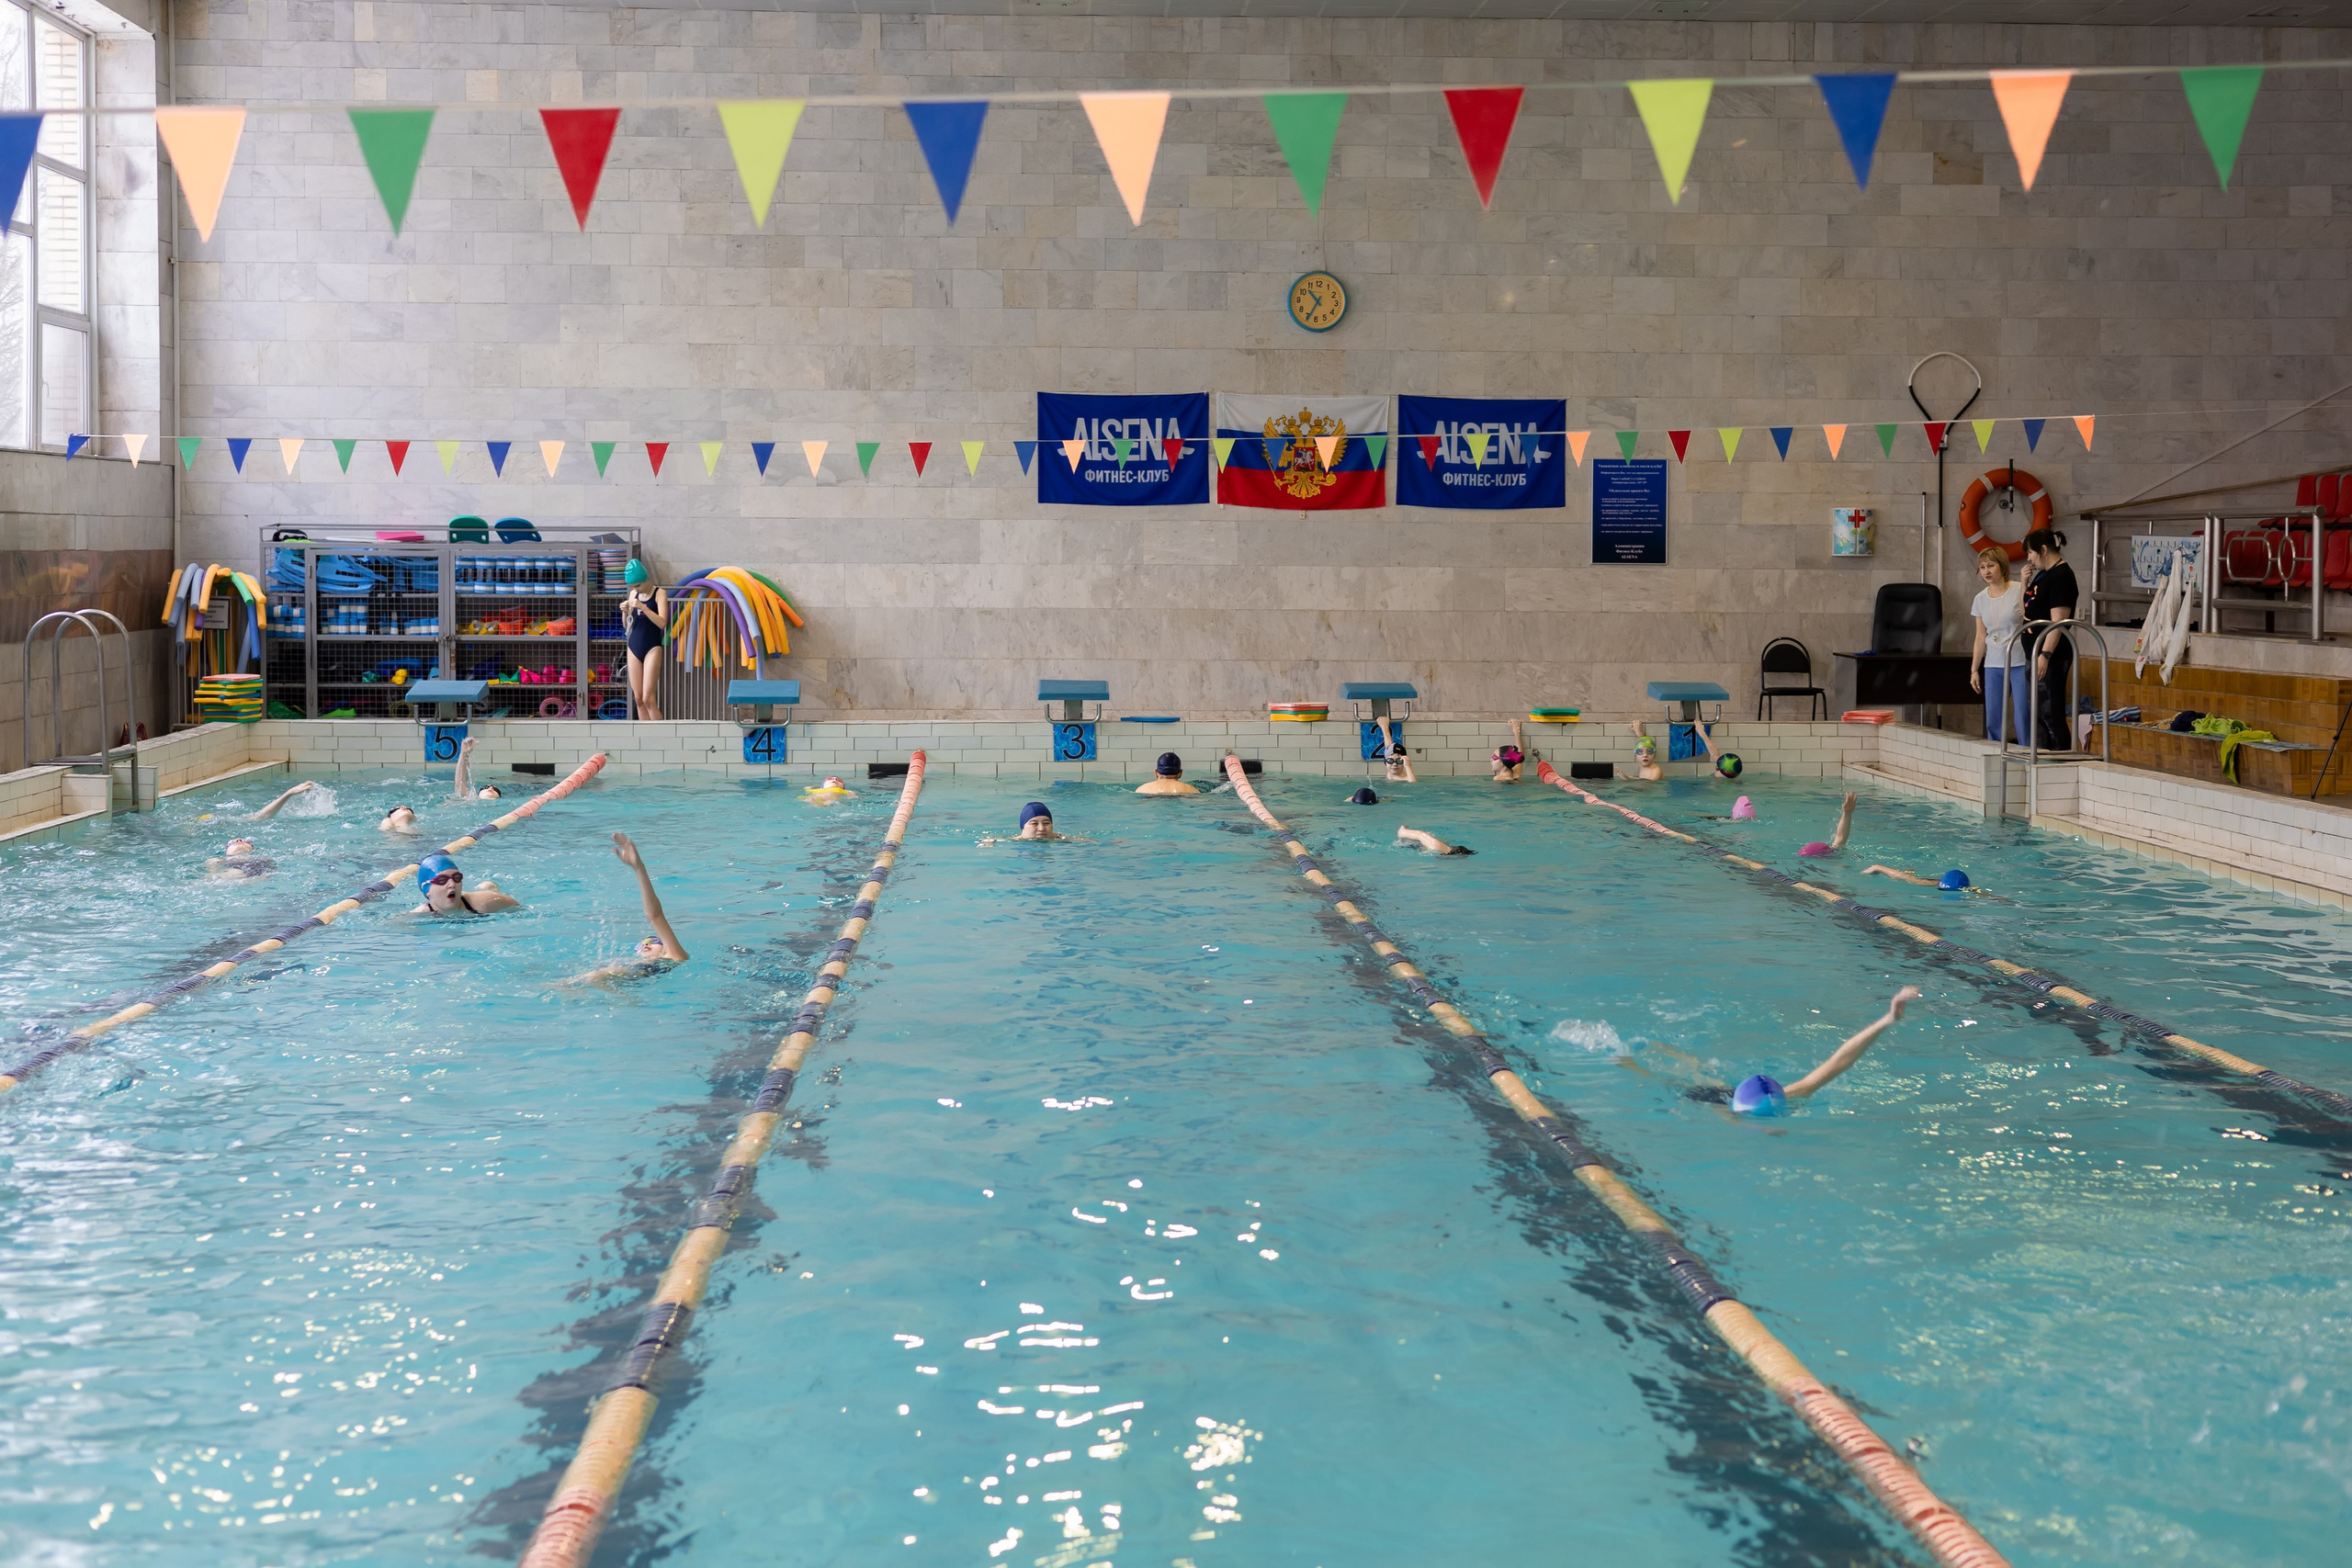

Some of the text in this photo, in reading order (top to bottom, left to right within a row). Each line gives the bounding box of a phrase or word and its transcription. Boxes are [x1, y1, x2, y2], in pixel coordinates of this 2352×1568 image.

[1084, 468, 1170, 483] ФИТНЕС-КЛУБ
[1442, 471, 1527, 487] ФИТНЕС-КЛУБ
[434, 726, 458, 761] 5
[752, 728, 776, 761] 4
[1063, 724, 1086, 760] 3
[1370, 724, 1393, 759] 2
[1683, 726, 1696, 757] 1
